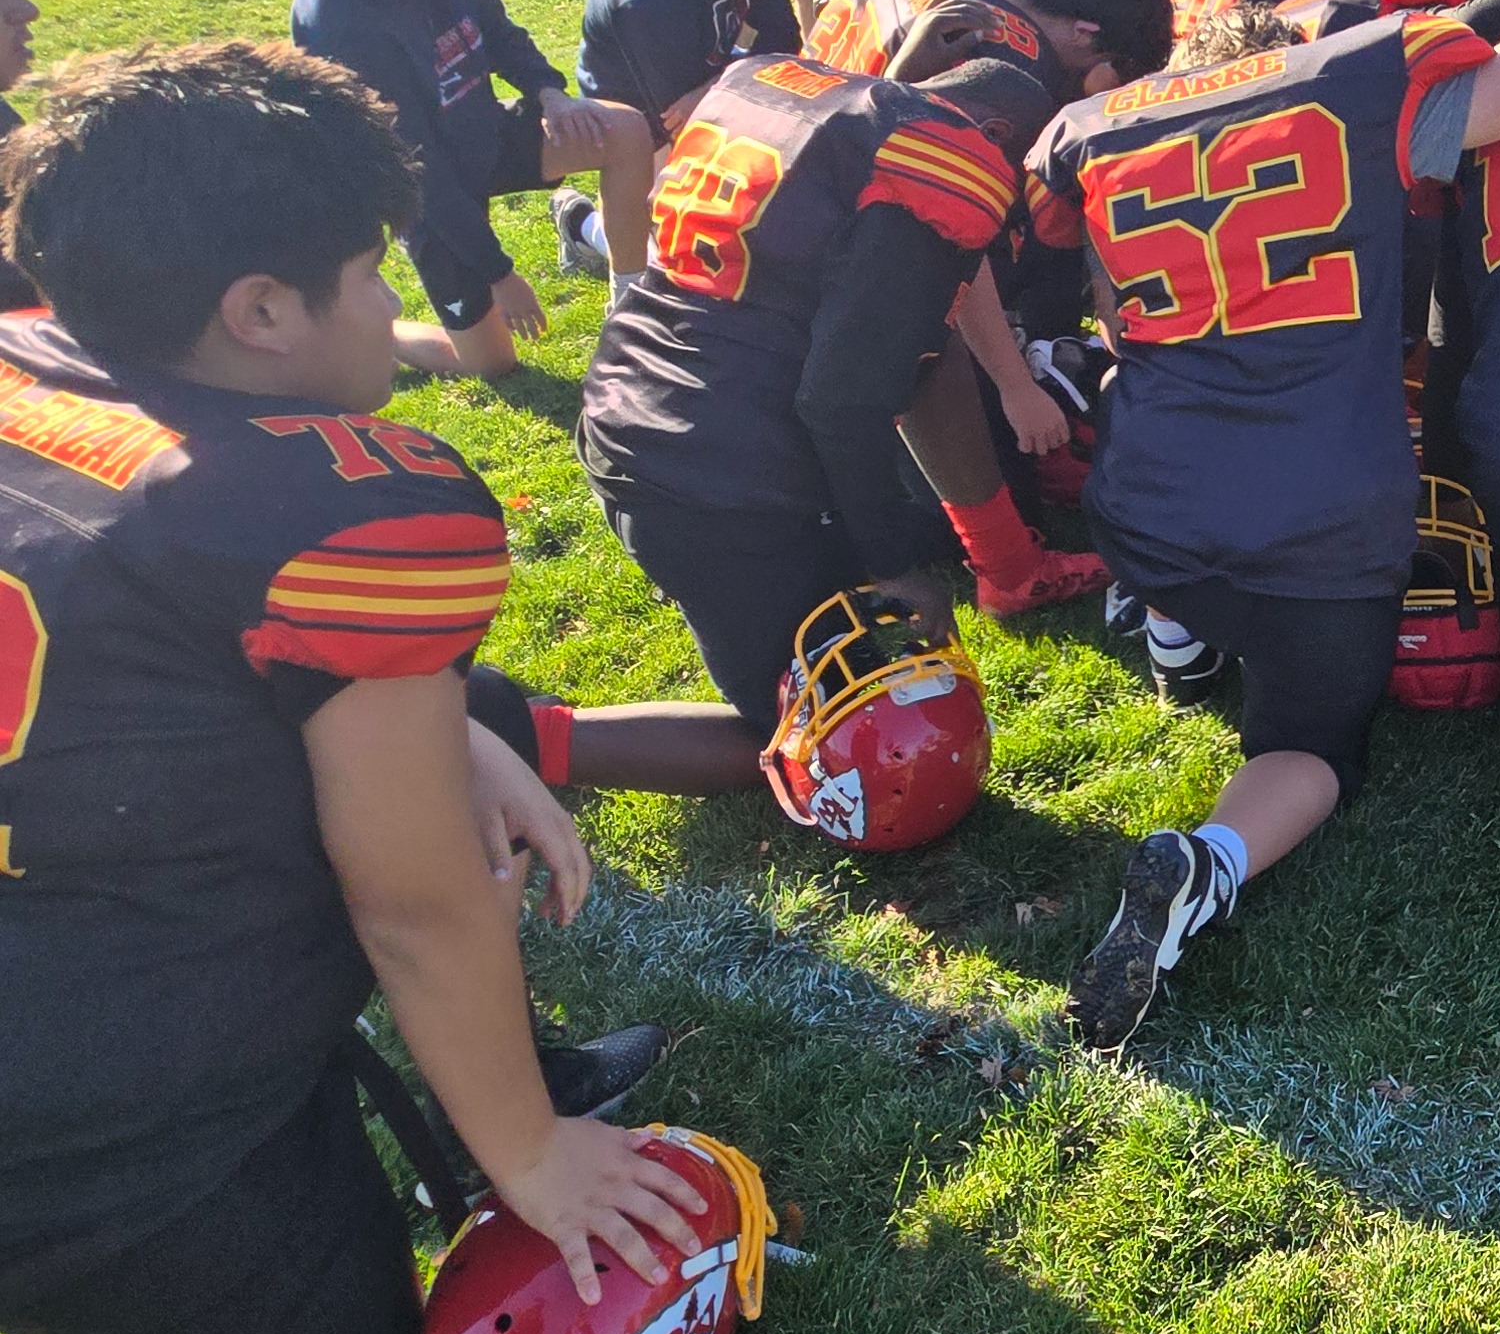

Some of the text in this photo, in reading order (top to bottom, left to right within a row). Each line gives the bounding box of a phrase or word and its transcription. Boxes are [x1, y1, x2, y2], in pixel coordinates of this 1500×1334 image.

[1103, 51, 1288, 118] CLARKE
[1076, 101, 1363, 345] 52
[247, 413, 468, 483] 72
